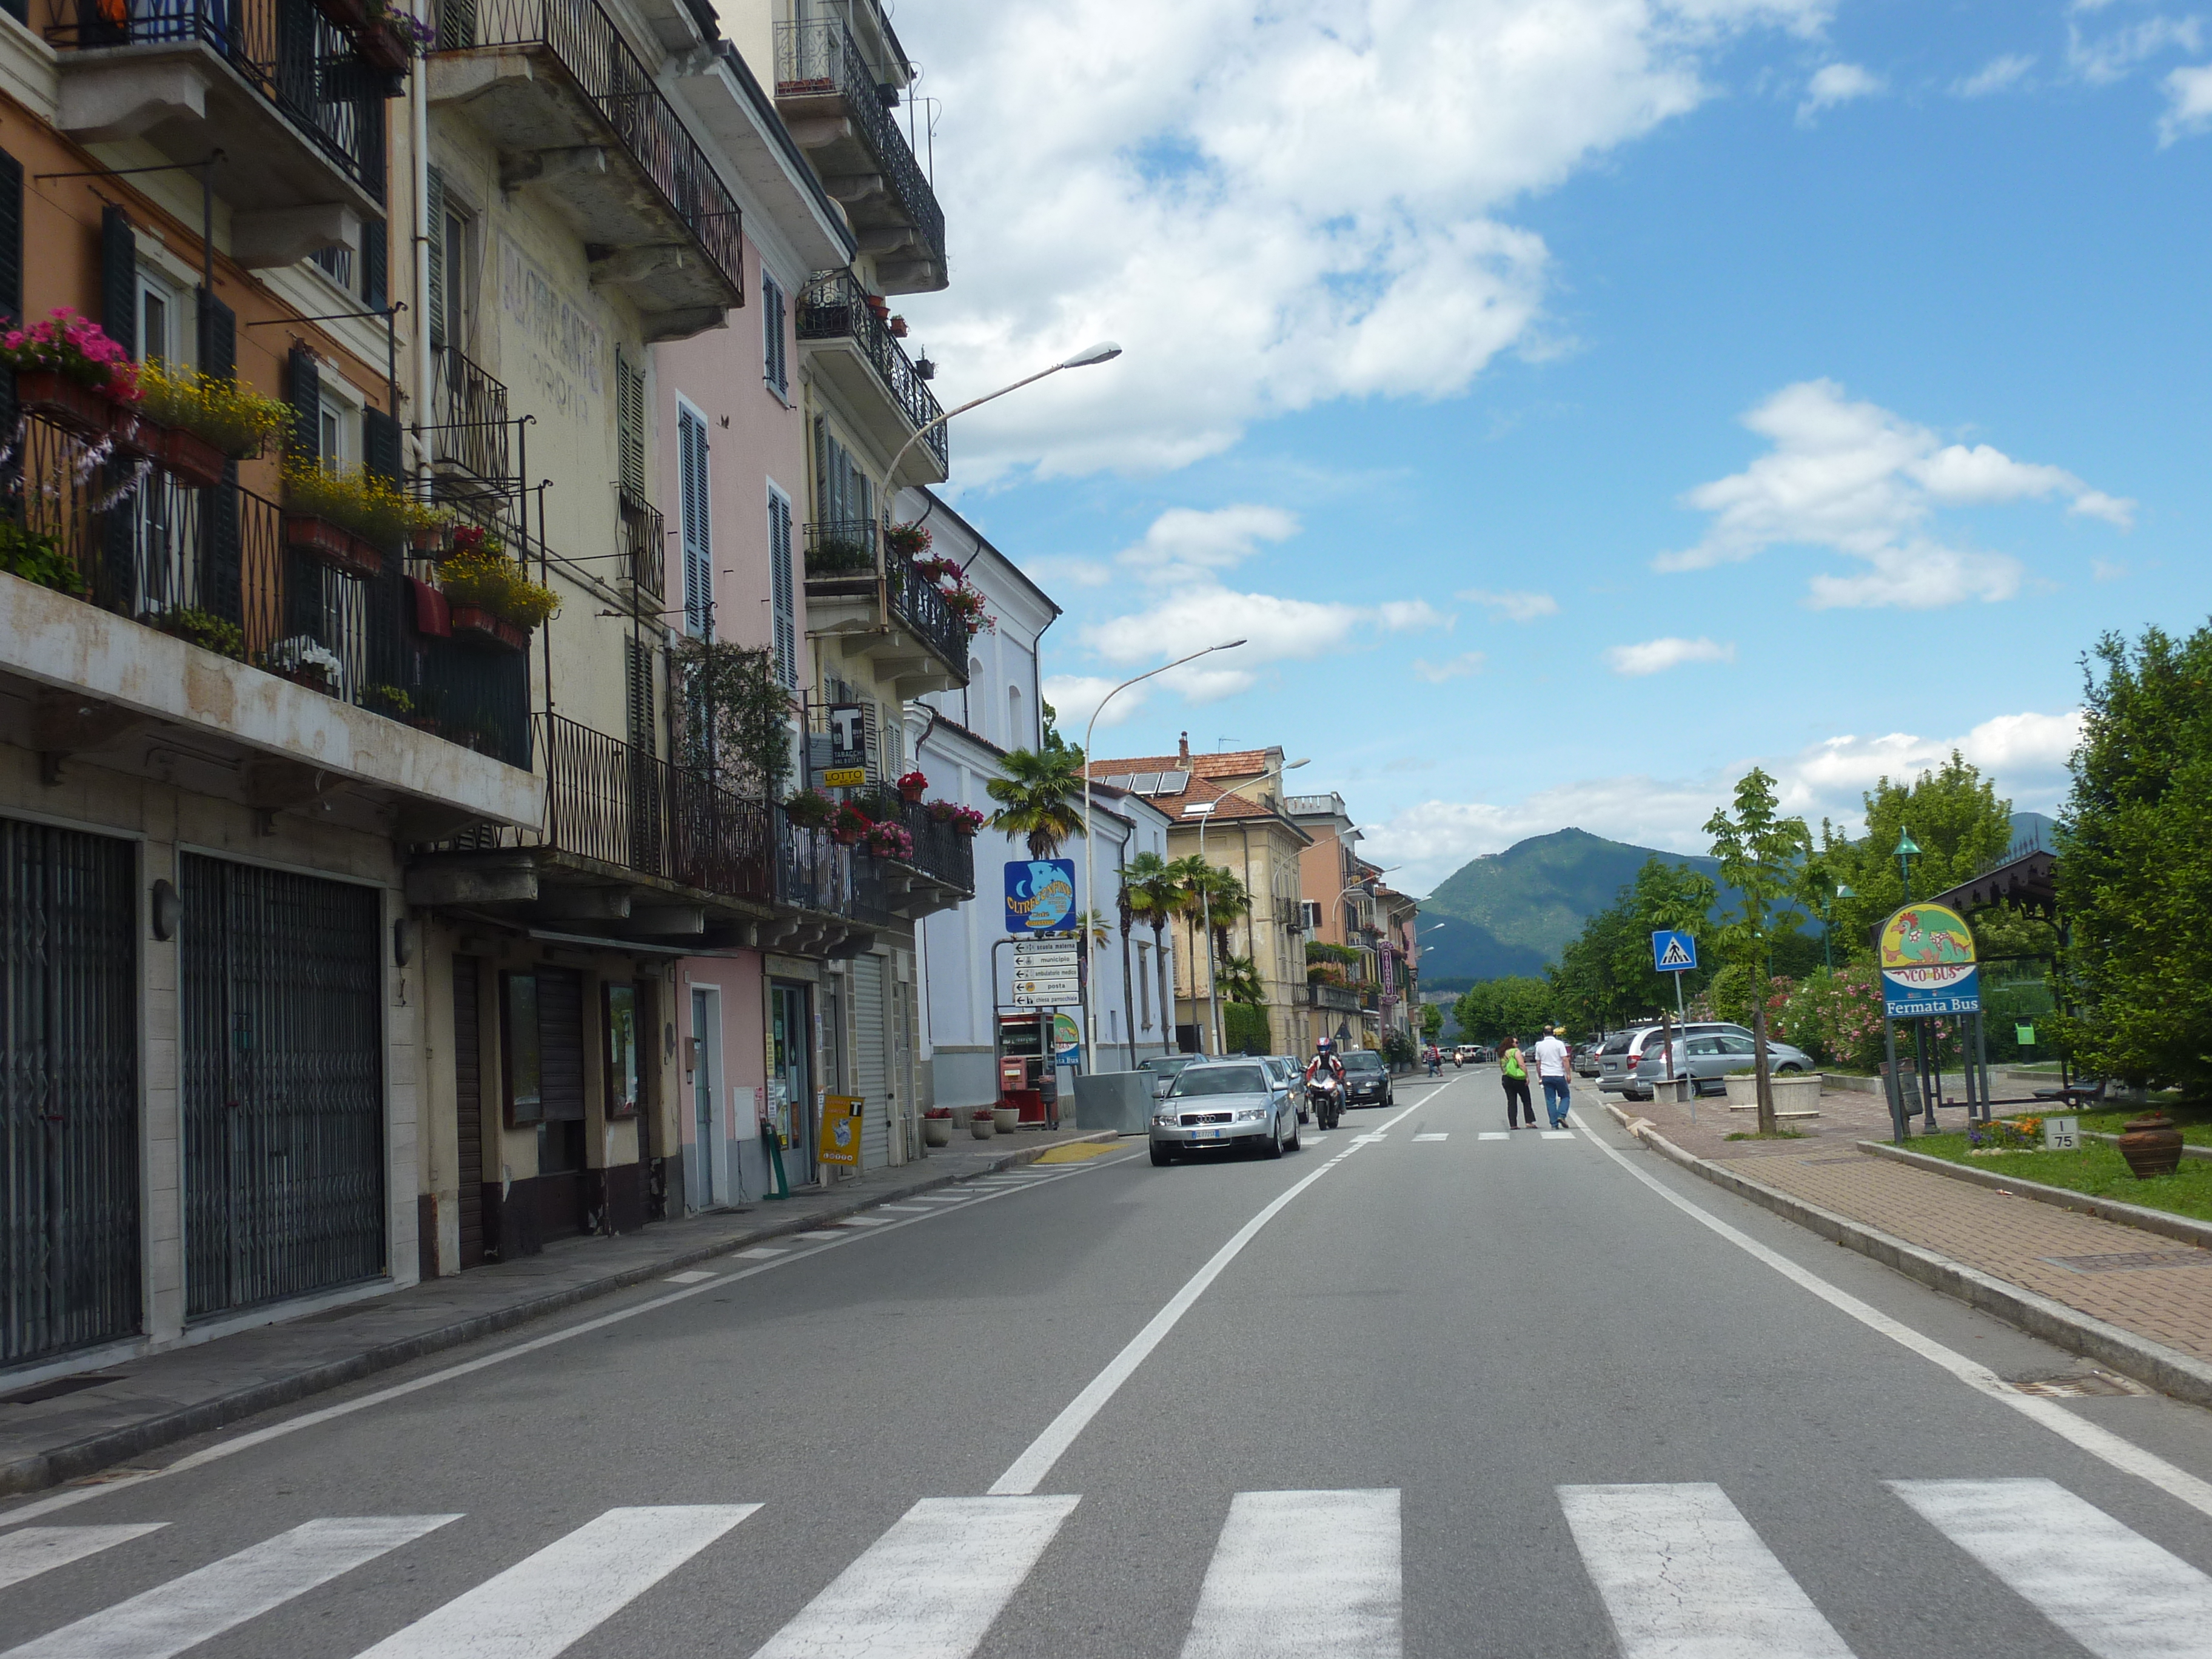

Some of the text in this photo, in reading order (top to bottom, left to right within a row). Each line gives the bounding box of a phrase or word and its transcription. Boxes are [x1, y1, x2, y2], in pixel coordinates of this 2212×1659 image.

[834, 709, 859, 750] T
[825, 771, 862, 781] LOTTO
[1898, 967, 1960, 982] VCO BUS
[1887, 998, 1978, 1014] Fermata Bus
[851, 1101, 862, 1115] T
[2054, 1136, 2073, 1147] 75
